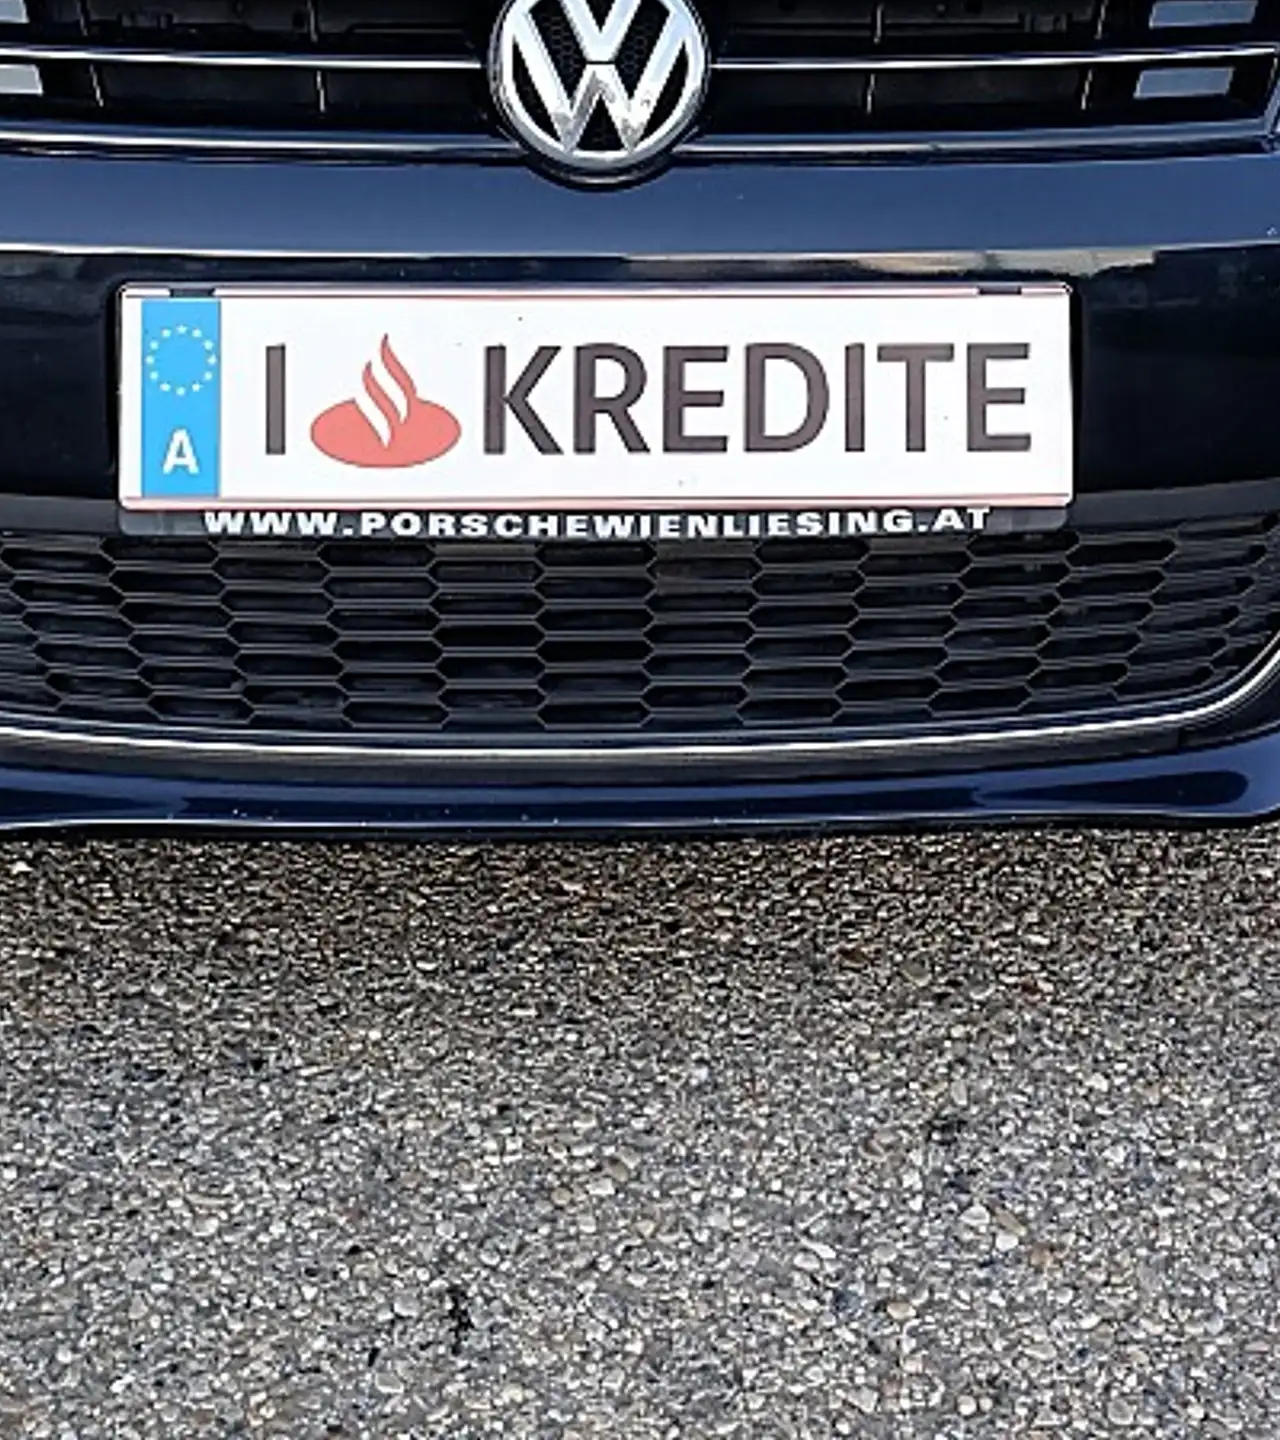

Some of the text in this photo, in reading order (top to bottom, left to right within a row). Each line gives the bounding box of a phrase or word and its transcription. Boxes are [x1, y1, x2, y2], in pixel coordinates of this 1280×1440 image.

[265, 342, 1032, 456] I KREDITE
[161, 428, 200, 474] A
[204, 507, 990, 538] WWW.PORSCHEWIENLIESING.AT
